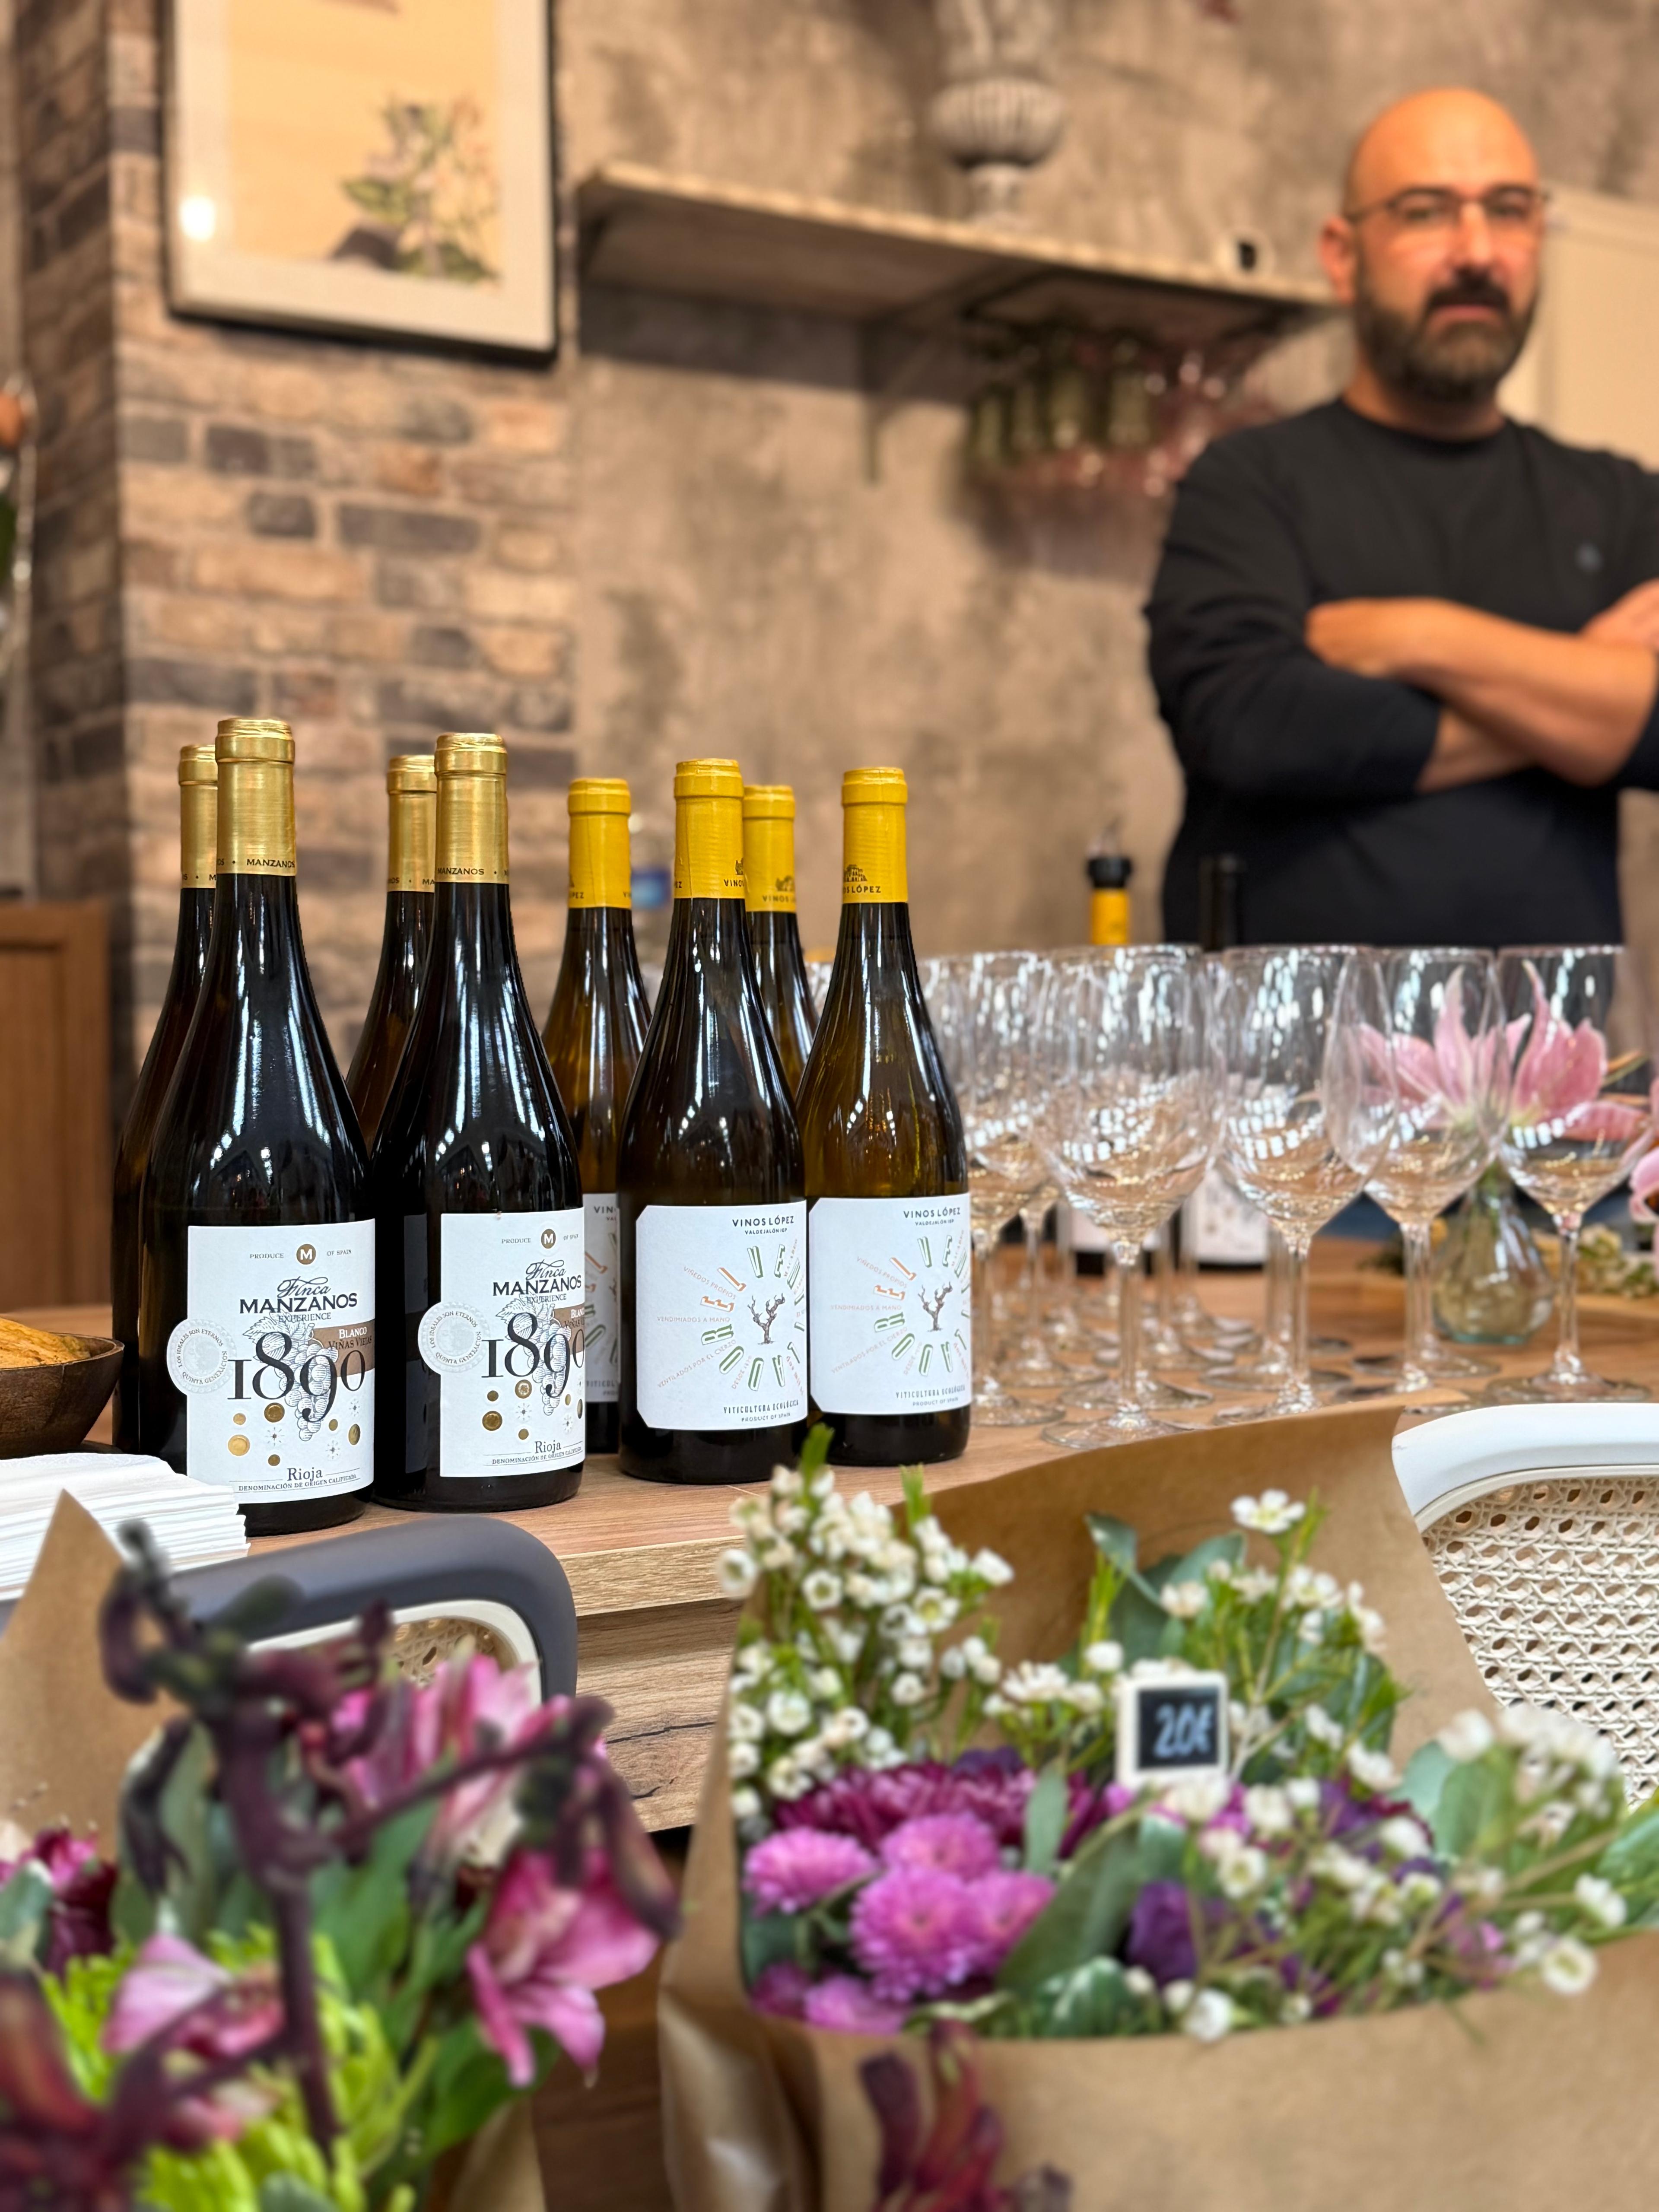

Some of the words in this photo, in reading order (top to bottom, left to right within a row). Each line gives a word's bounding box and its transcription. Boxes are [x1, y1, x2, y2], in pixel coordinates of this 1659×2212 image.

[247, 859, 295, 868] MANZANOS
[903, 1210, 934, 1218] VINOS
[938, 1207, 960, 1216] LÓPEZ
[732, 1218, 766, 1227] VINOS
[769, 1215, 794, 1226] LÓPEZ
[544, 1234, 553, 1245] M
[300, 1249, 313, 1260] M
[526, 1259, 566, 1281] Finca
[857, 1256, 882, 1274] VIÑEDOS
[883, 1271, 907, 1288] PROPIOS
[277, 1276, 331, 1298] Finca
[493, 1275, 582, 1296] MANZANOS
[684, 1267, 710, 1285] VIÑEDOS
[710, 1282, 736, 1300] PROPIOS
[239, 1293, 357, 1314] MANZANOS
[455, 1311, 478, 1328] ETERNOS
[176, 1333, 189, 1354] IDEALES
[201, 1329, 224, 1347] ETERNOS
[435, 1352, 458, 1364] QUINTA
[481, 1313, 585, 1398] 1890
[182, 1372, 203, 1385] QUINTA
[227, 1332, 366, 1423] 1890
[896, 1389, 940, 1398] VITICULTURA
[724, 1405, 770, 1414] VITICULTURA
[534, 1440, 562, 1454] Rioja
[492, 1456, 540, 1465] DENOMINACIÓN
[287, 1467, 323, 1482] Rioja
[238, 1482, 292, 1491] DENOMINACIÓN
[1153, 1704, 1212, 1758] 20€
